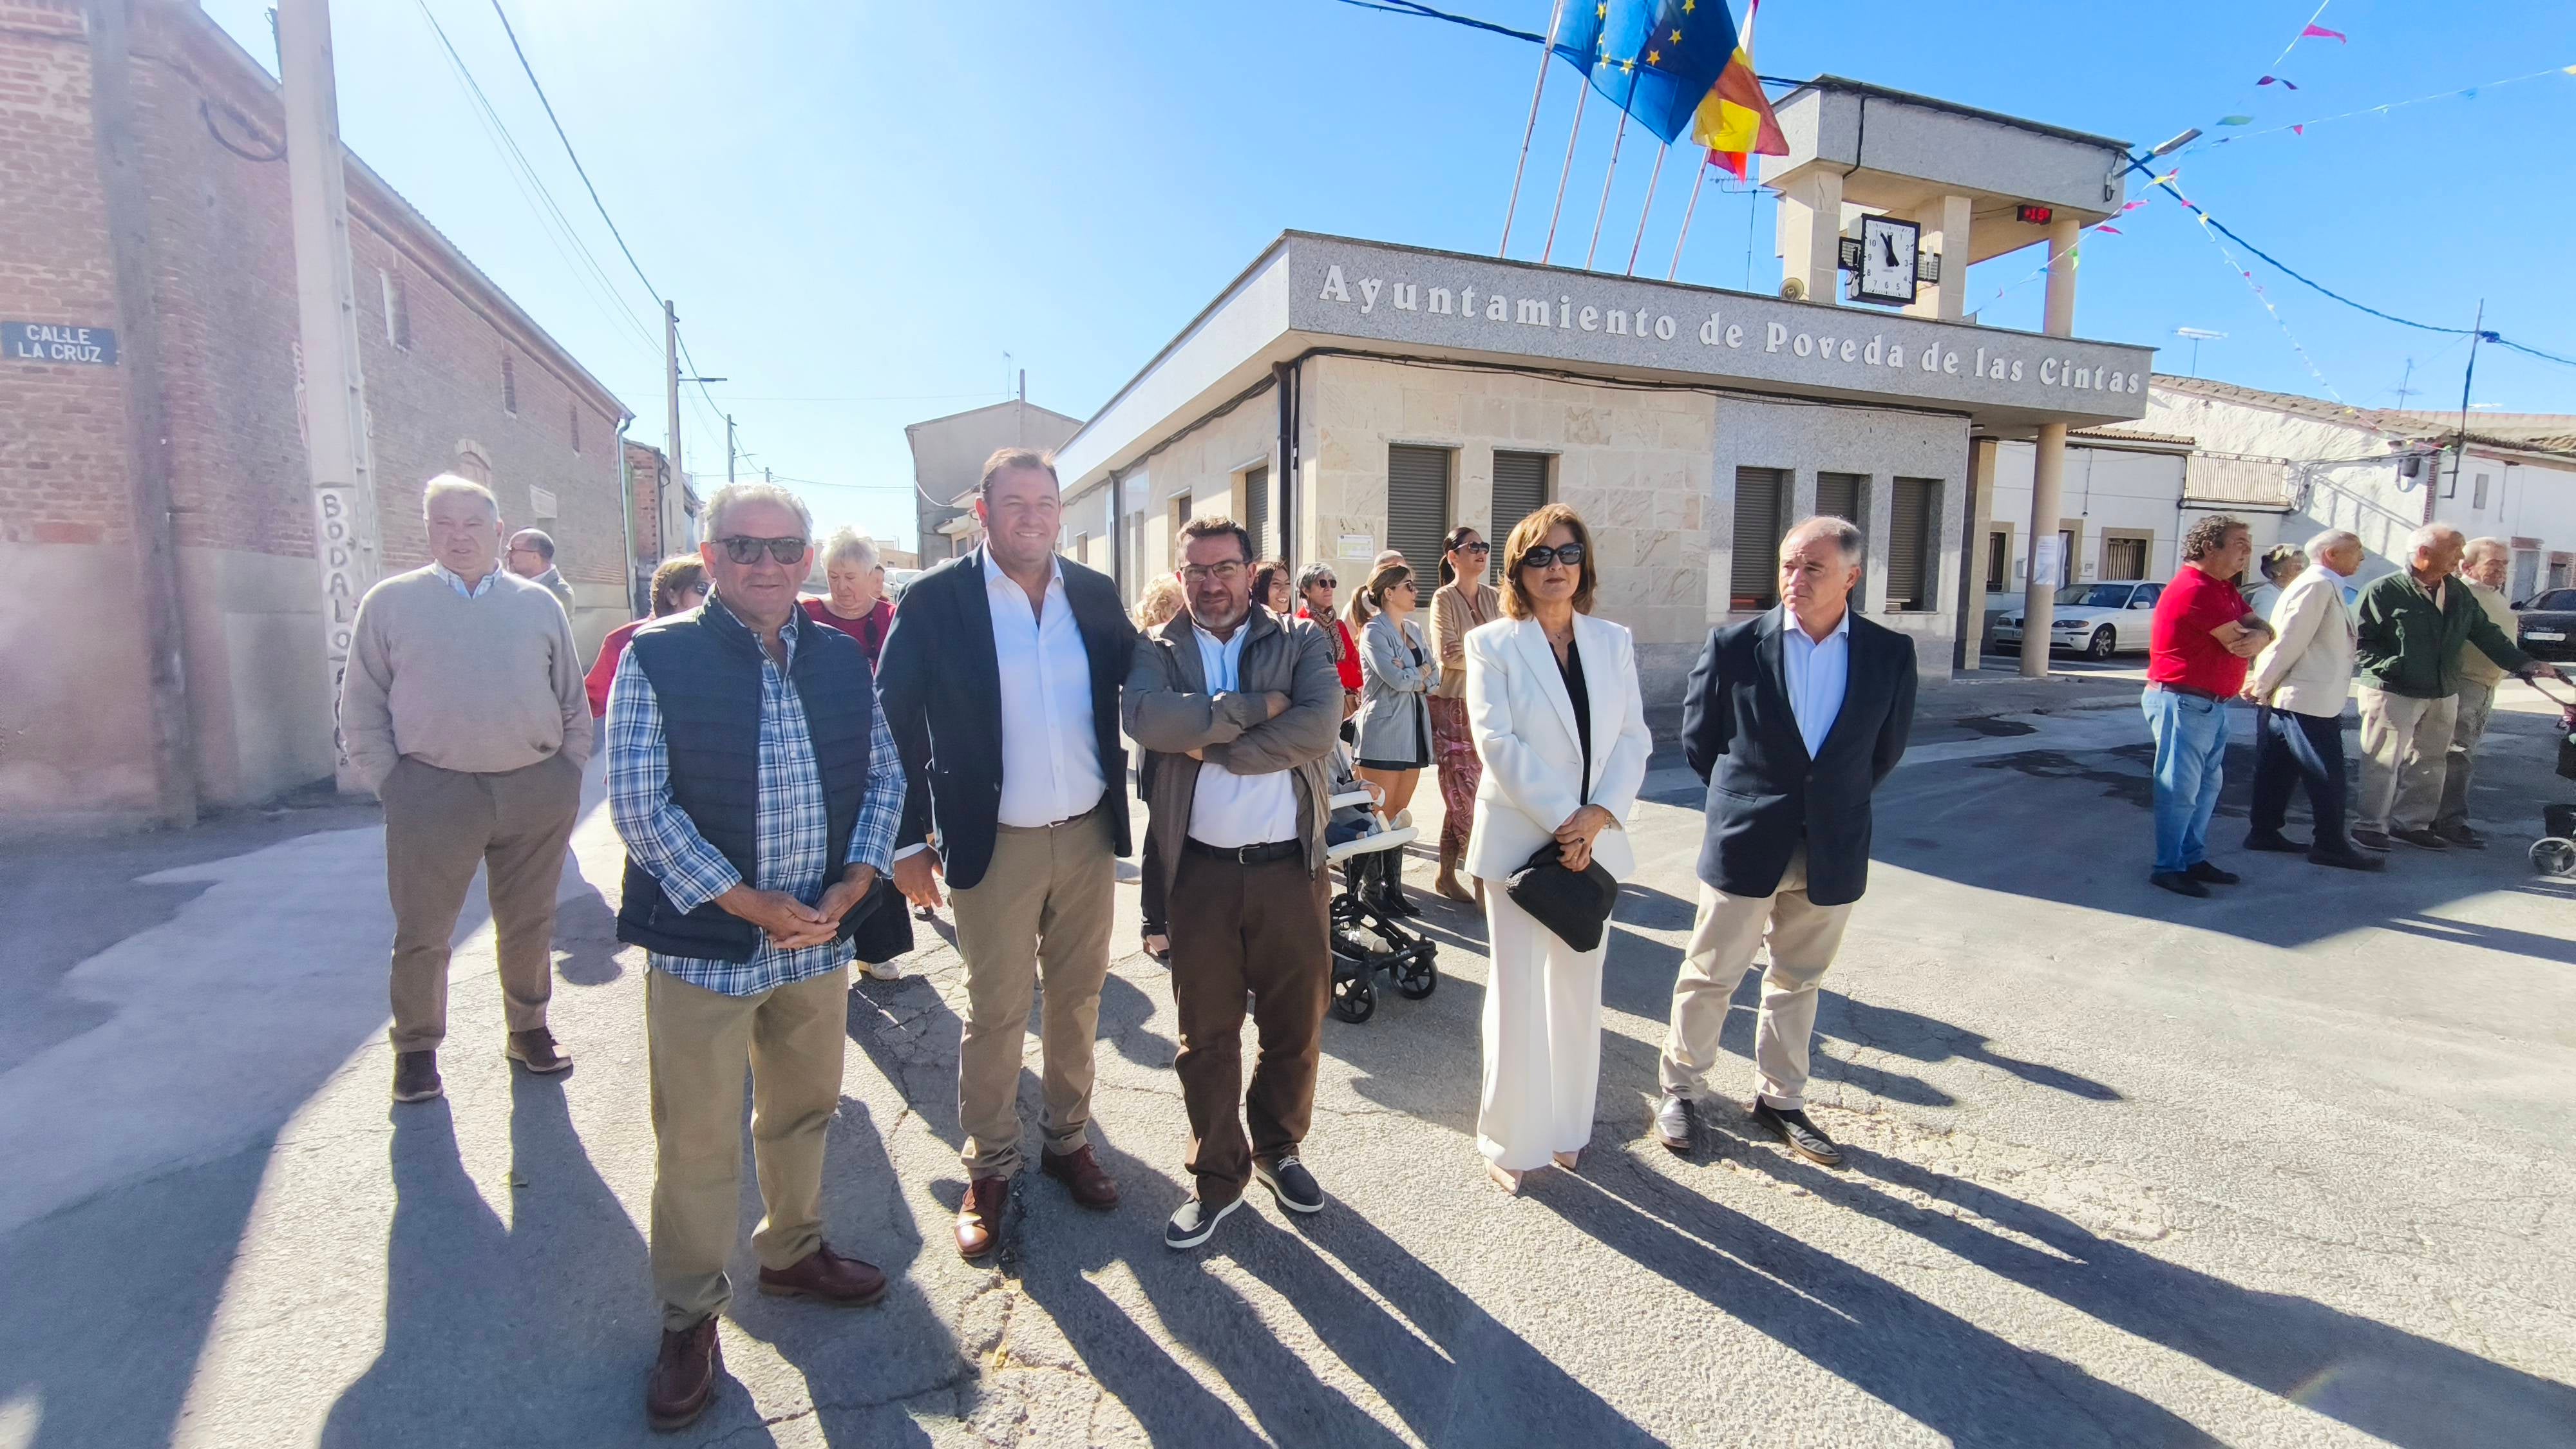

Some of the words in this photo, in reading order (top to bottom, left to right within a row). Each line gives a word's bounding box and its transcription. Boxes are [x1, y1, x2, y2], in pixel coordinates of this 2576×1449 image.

[1868, 253, 1872, 261] 9
[1904, 259, 1909, 267] 3
[26, 325, 91, 345] CALLE
[1320, 265, 1676, 340] Ayuntamiento
[1699, 312, 1743, 348] de
[1765, 322, 1904, 368] Poveda
[1921, 341, 1959, 374] de
[1975, 347, 2023, 382] las
[2040, 357, 2139, 394] Cintas
[18, 341, 44, 358] LA
[51, 344, 103, 363] CRUZ
